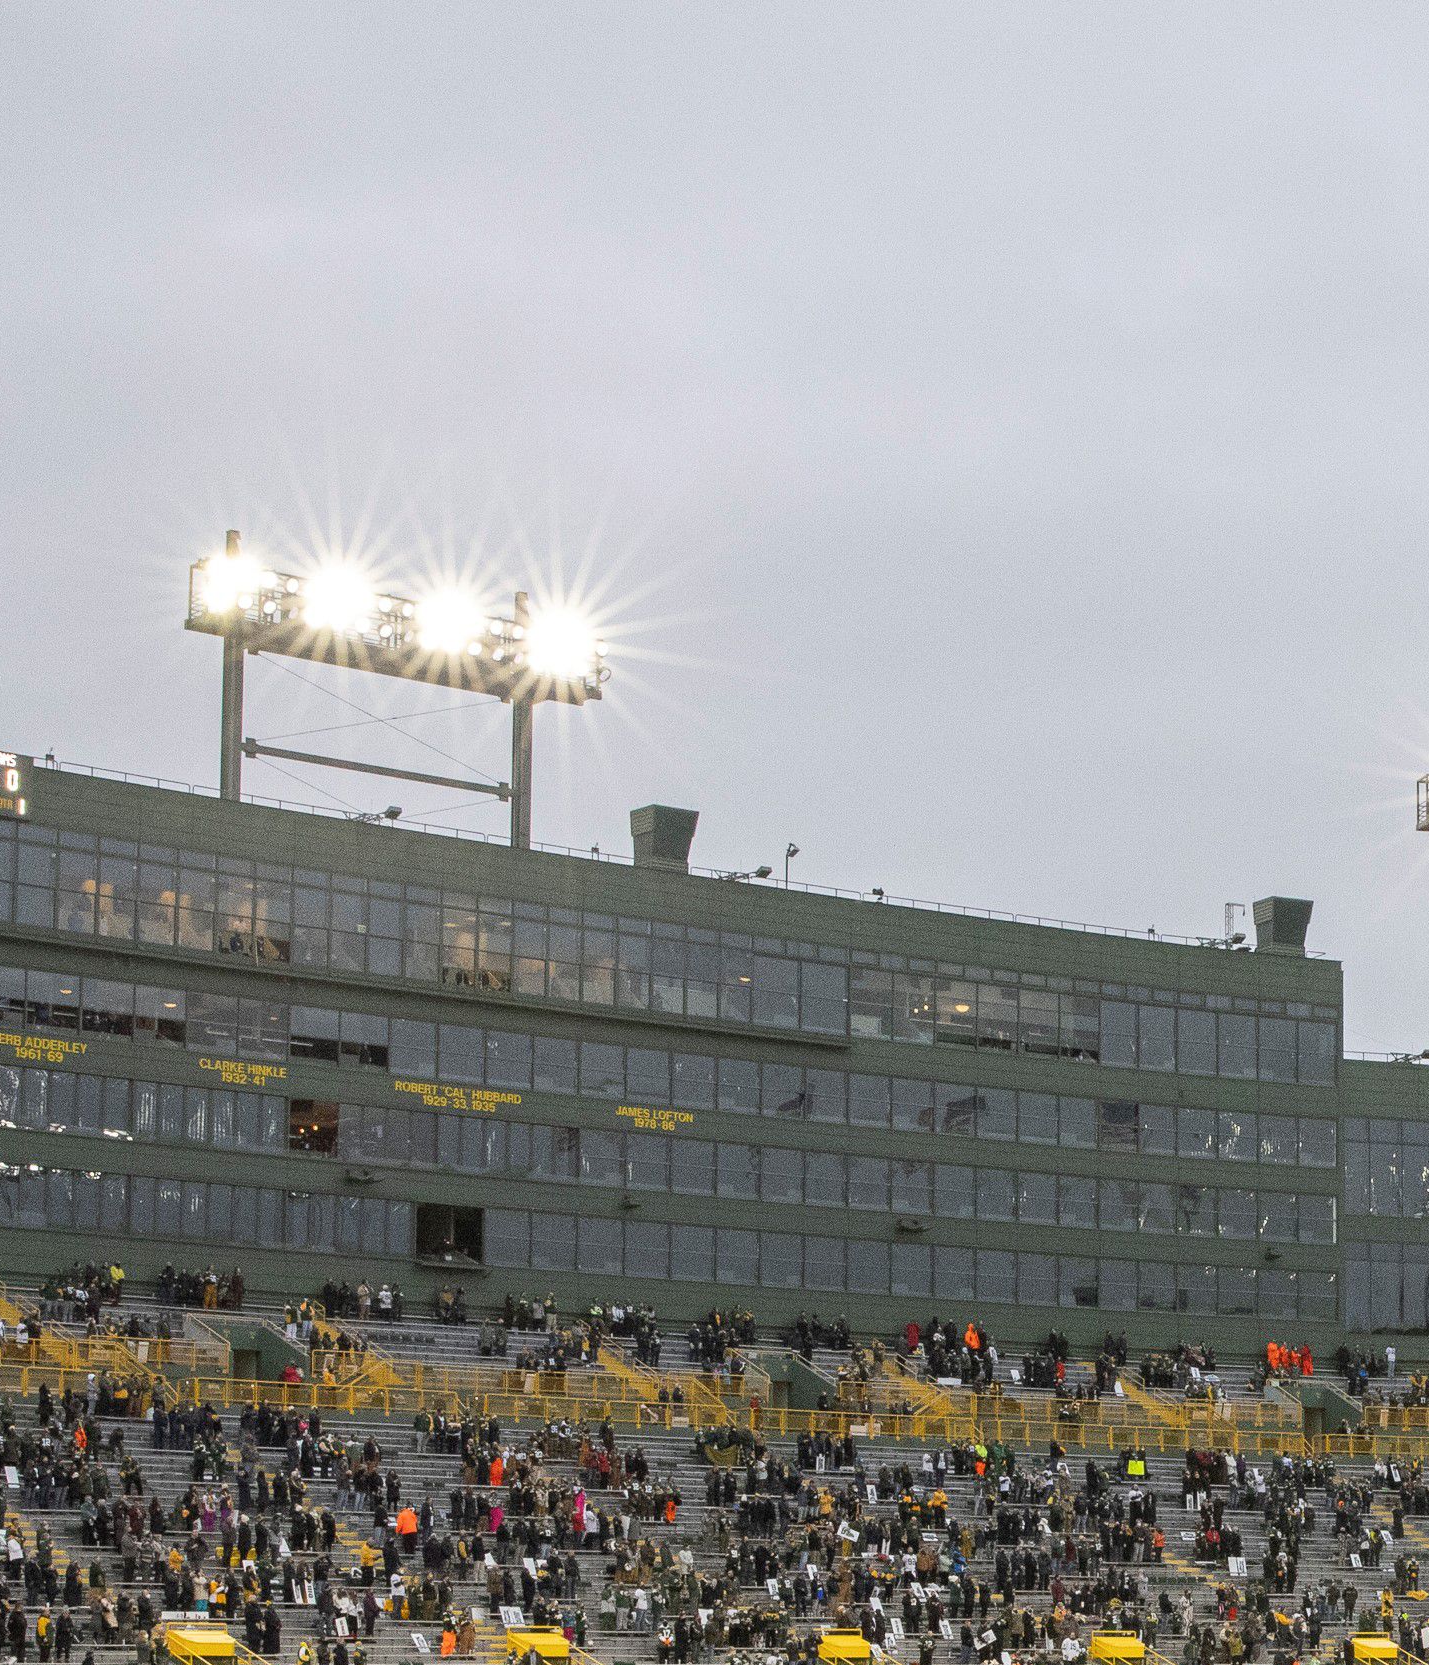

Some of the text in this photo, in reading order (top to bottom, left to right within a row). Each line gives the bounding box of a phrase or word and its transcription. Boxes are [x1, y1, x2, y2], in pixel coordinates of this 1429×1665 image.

[5, 768, 19, 792] 0
[24, 1035, 88, 1056] ADDERLEY
[14, 1046, 64, 1064] 1961-69
[200, 1057, 288, 1079] CLARKE HINKLE
[221, 1070, 266, 1087] 1932-41
[395, 1080, 437, 1096] ROBERT
[472, 1090, 521, 1105] HUBBARD
[472, 1101, 496, 1113] 1935
[616, 1106, 693, 1124] JAMES LOFTON
[635, 1118, 675, 1131] 1978-86
